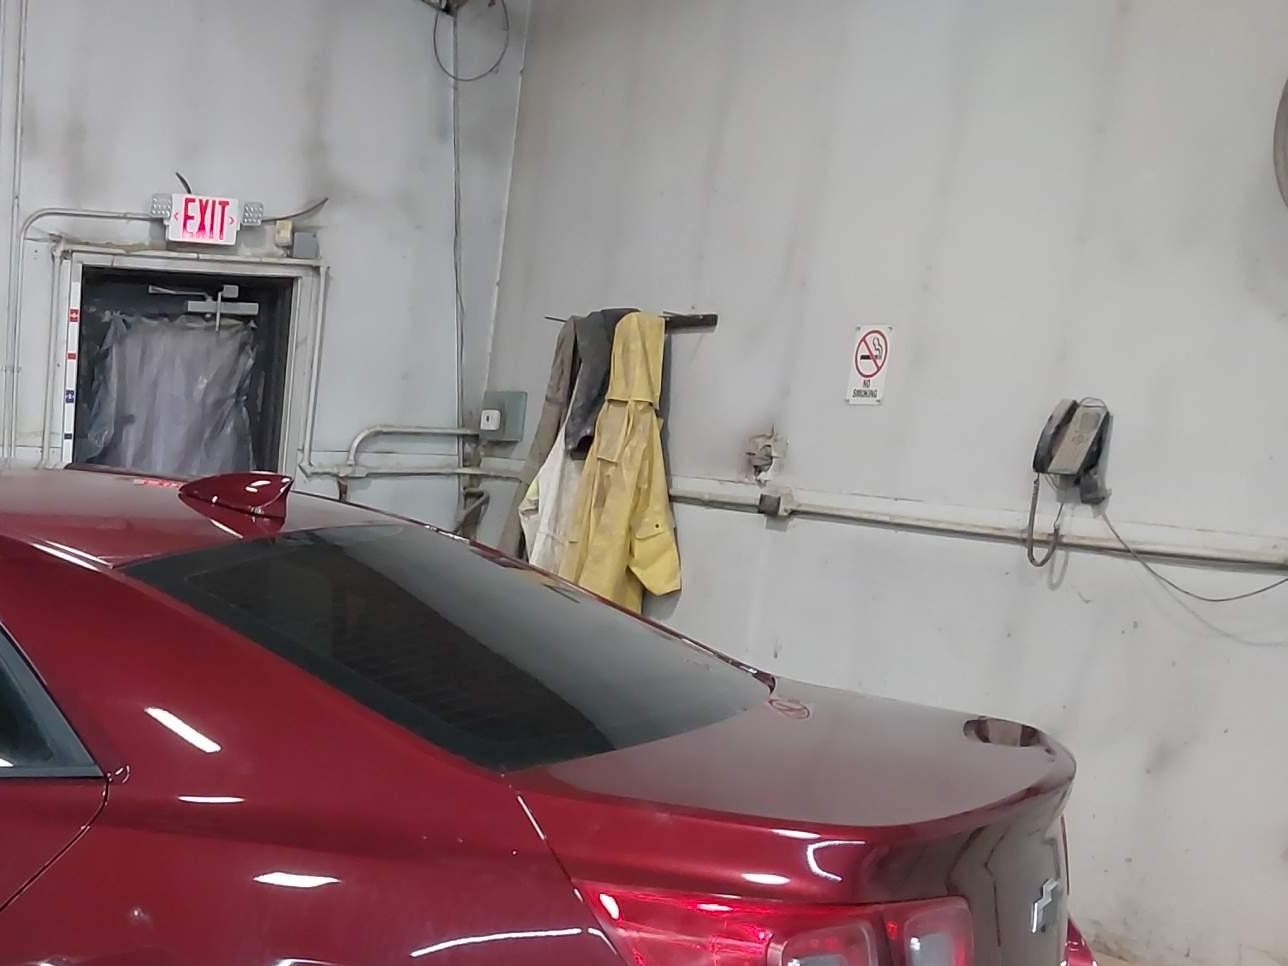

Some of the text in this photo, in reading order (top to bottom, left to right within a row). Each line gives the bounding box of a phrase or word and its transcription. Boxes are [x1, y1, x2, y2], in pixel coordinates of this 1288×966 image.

[182, 197, 230, 240] EXIT
[863, 379, 870, 388] NO
[852, 389, 878, 398] SMOKING
